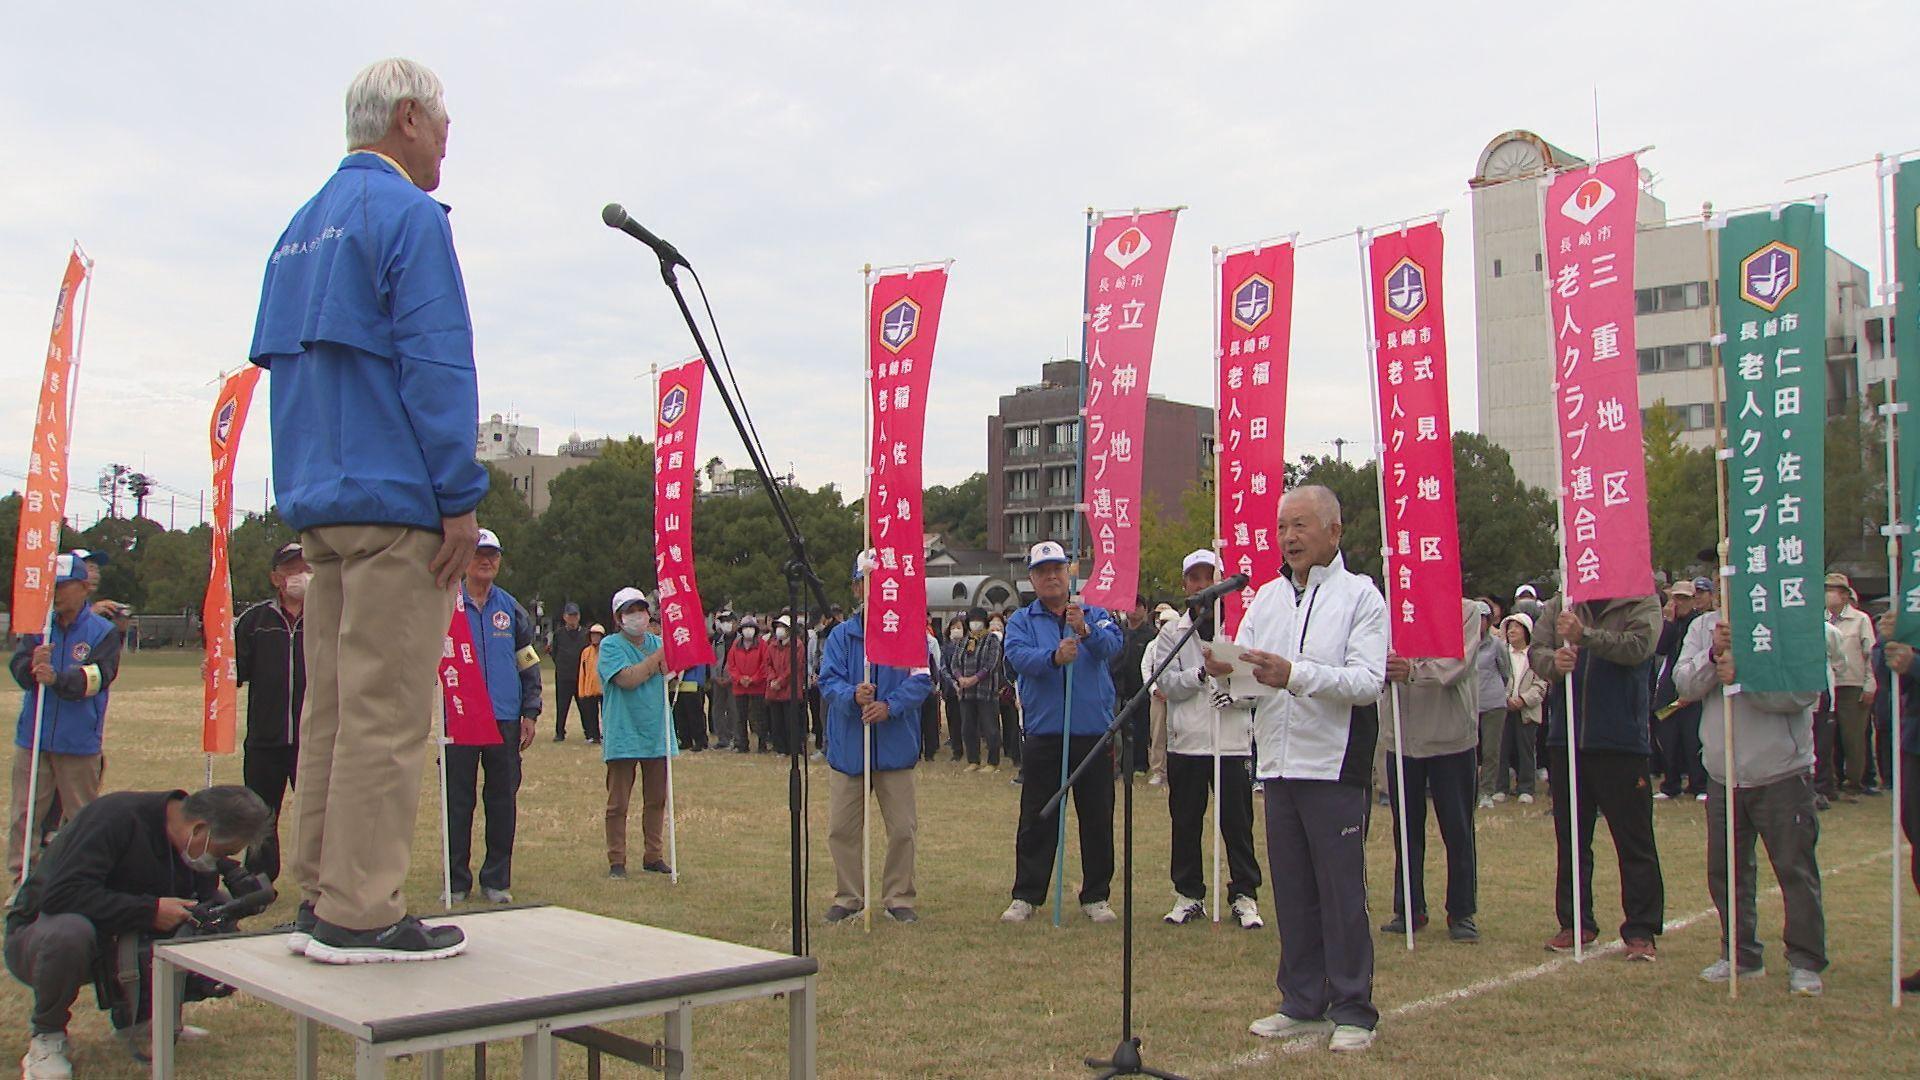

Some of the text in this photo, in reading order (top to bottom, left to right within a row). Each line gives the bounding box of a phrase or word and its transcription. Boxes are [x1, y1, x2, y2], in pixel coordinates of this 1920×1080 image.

[1099, 274, 1143, 292] 長崎市
[1229, 336, 1271, 356] 長崎市
[1388, 327, 1431, 350] 長崎市
[1560, 226, 1612, 254] 長崎市
[1740, 314, 1799, 341] 長崎市
[878, 359, 914, 379] 長崎市
[1089, 304, 1119, 591] 老人クラブ連合会
[1112, 299, 1146, 528] 立神地区
[1250, 362, 1271, 552] 福田地区
[1413, 359, 1443, 562] 式見地区
[1556, 264, 1600, 584] 老人クラブ連合会
[1588, 254, 1630, 507] 三重地区
[876, 390, 899, 633] 老人クラブ連合会
[892, 385, 916, 577] 稲佐地区
[1228, 366, 1257, 610] 老人クラブ連合会
[1387, 361, 1415, 623] 老人クラブ連合会
[1739, 353, 1772, 652] 老人クラブ連合会
[1775, 347, 1806, 608] 仁田・佐古地区
